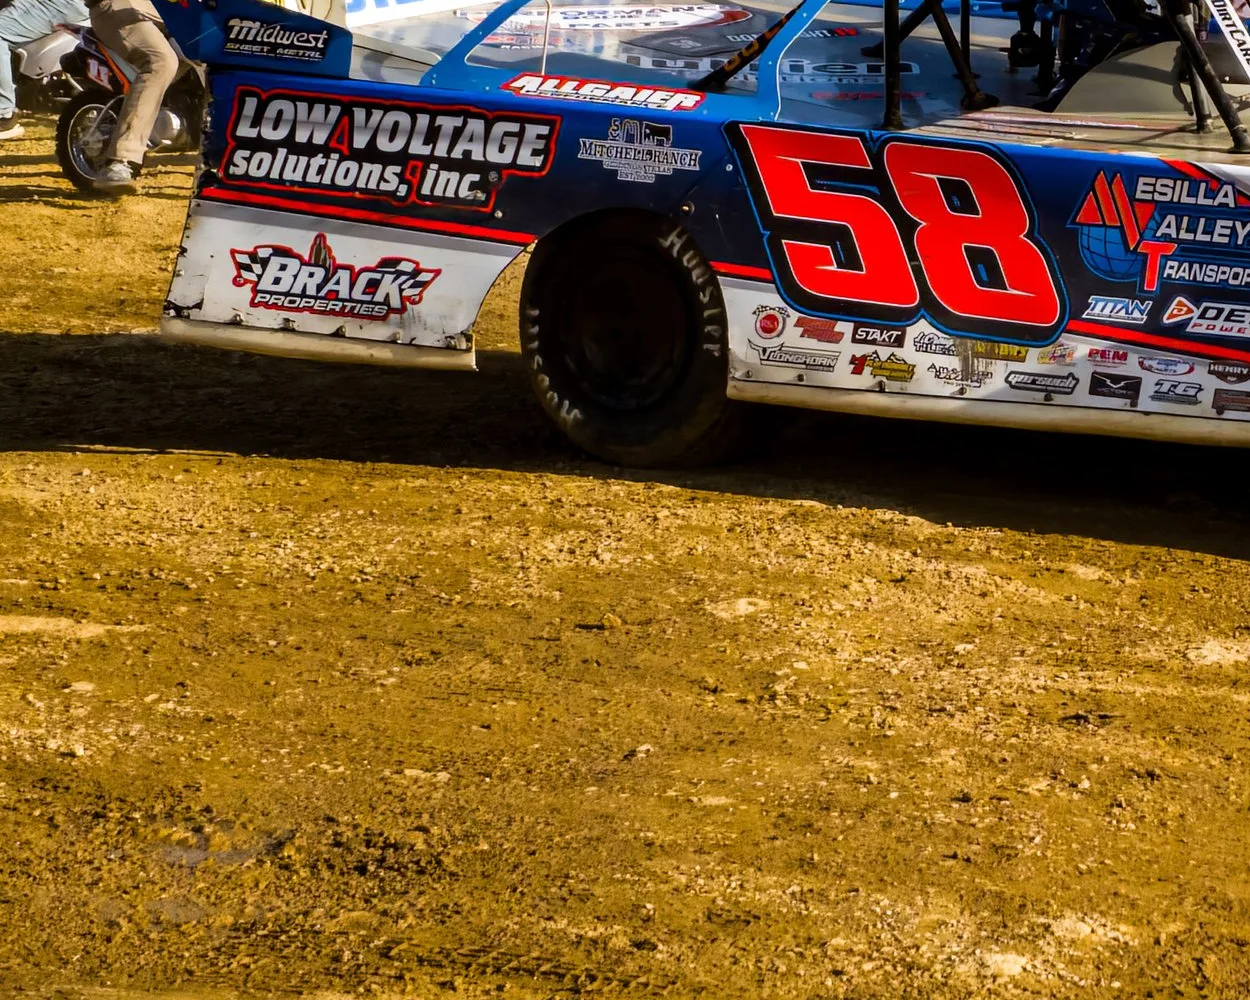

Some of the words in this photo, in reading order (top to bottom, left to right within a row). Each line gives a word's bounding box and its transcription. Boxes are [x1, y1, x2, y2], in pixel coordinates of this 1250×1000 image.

[227, 18, 329, 49] Midwest
[510, 75, 701, 111] ALLGAIER
[235, 96, 341, 146] LOW
[352, 106, 550, 167] VOLTAGE
[581, 140, 650, 161] MITCHELL
[651, 149, 699, 167] RANCH
[229, 147, 409, 196] solutions,
[739, 124, 1061, 327] 58
[256, 256, 410, 309] BRACK
[254, 294, 389, 316] PROPERTIES
[1088, 296, 1153, 317] TITAN
[855, 327, 902, 343] STAKT
[768, 351, 838, 367] LONGHORN
